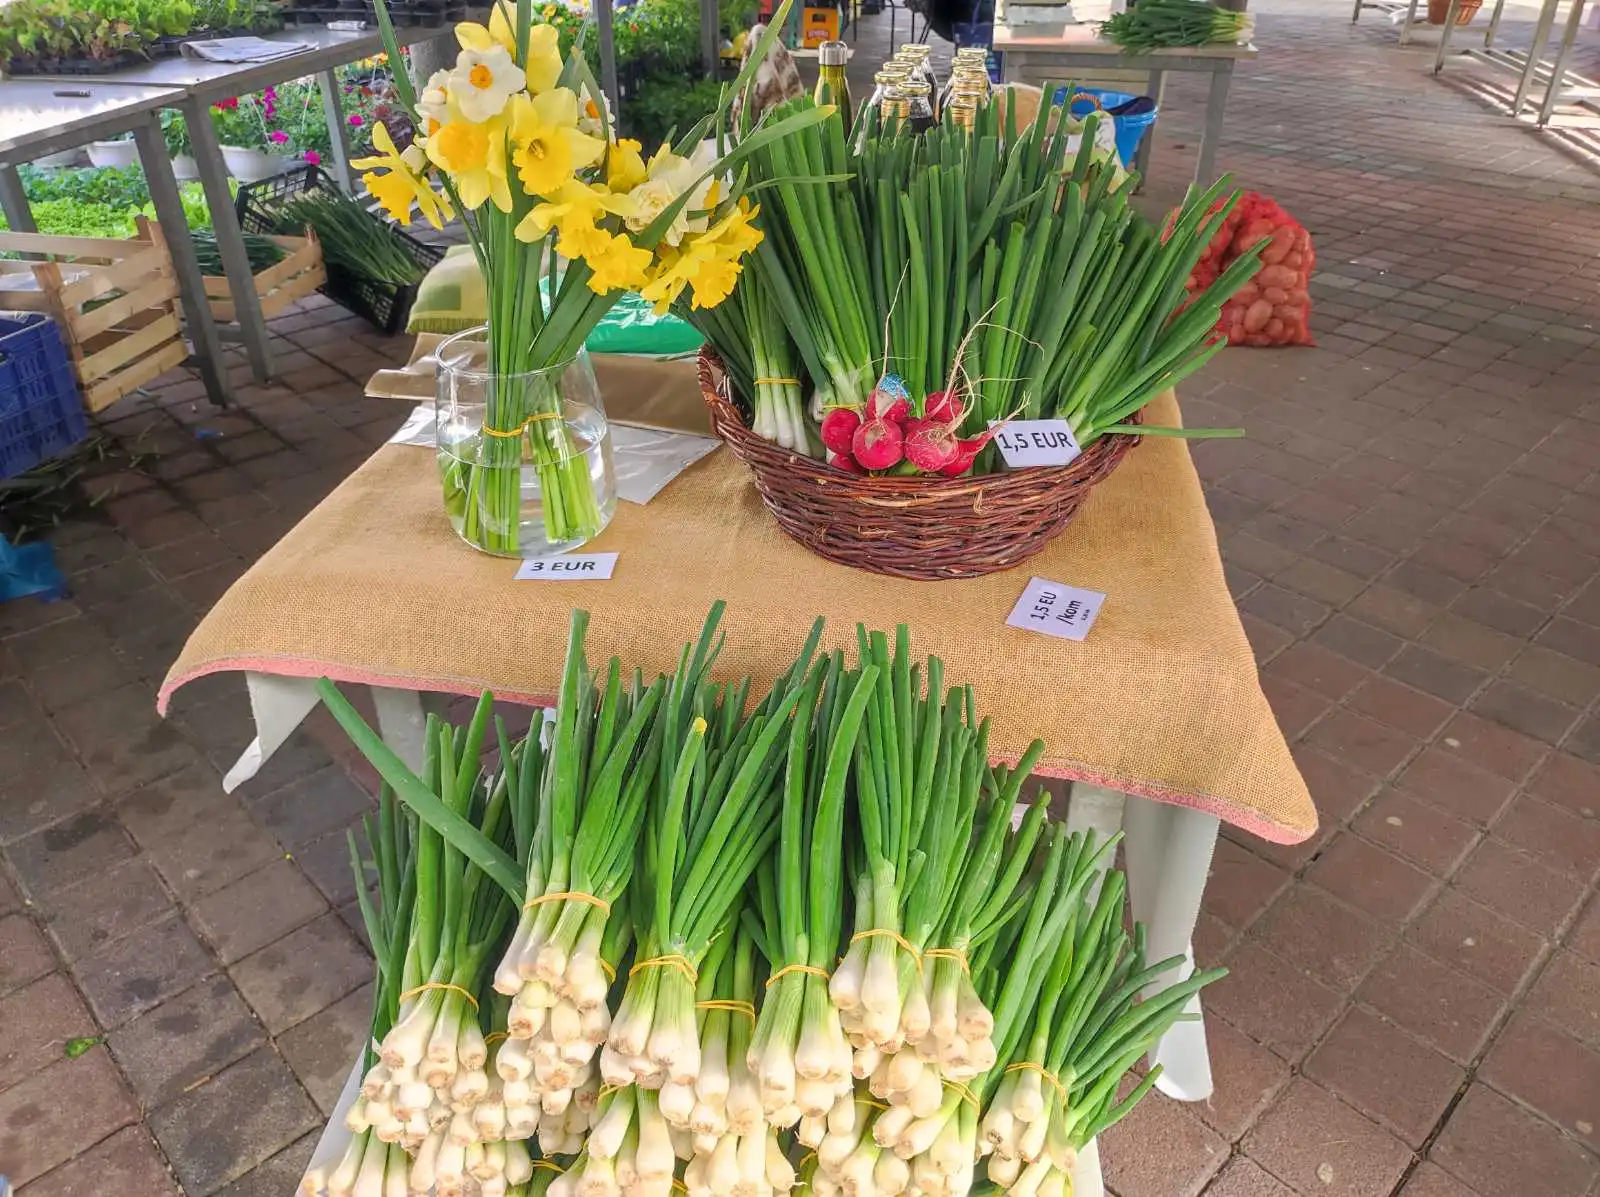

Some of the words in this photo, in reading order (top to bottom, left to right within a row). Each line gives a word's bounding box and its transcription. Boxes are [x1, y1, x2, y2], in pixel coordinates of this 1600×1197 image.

[998, 433, 1028, 452] 1,5
[1031, 432, 1073, 448] EUR
[531, 562, 545, 571] 3
[551, 561, 596, 571] EUR
[1038, 591, 1057, 605] EU
[1030, 605, 1050, 620] 1,5
[1056, 600, 1082, 625] /kom
